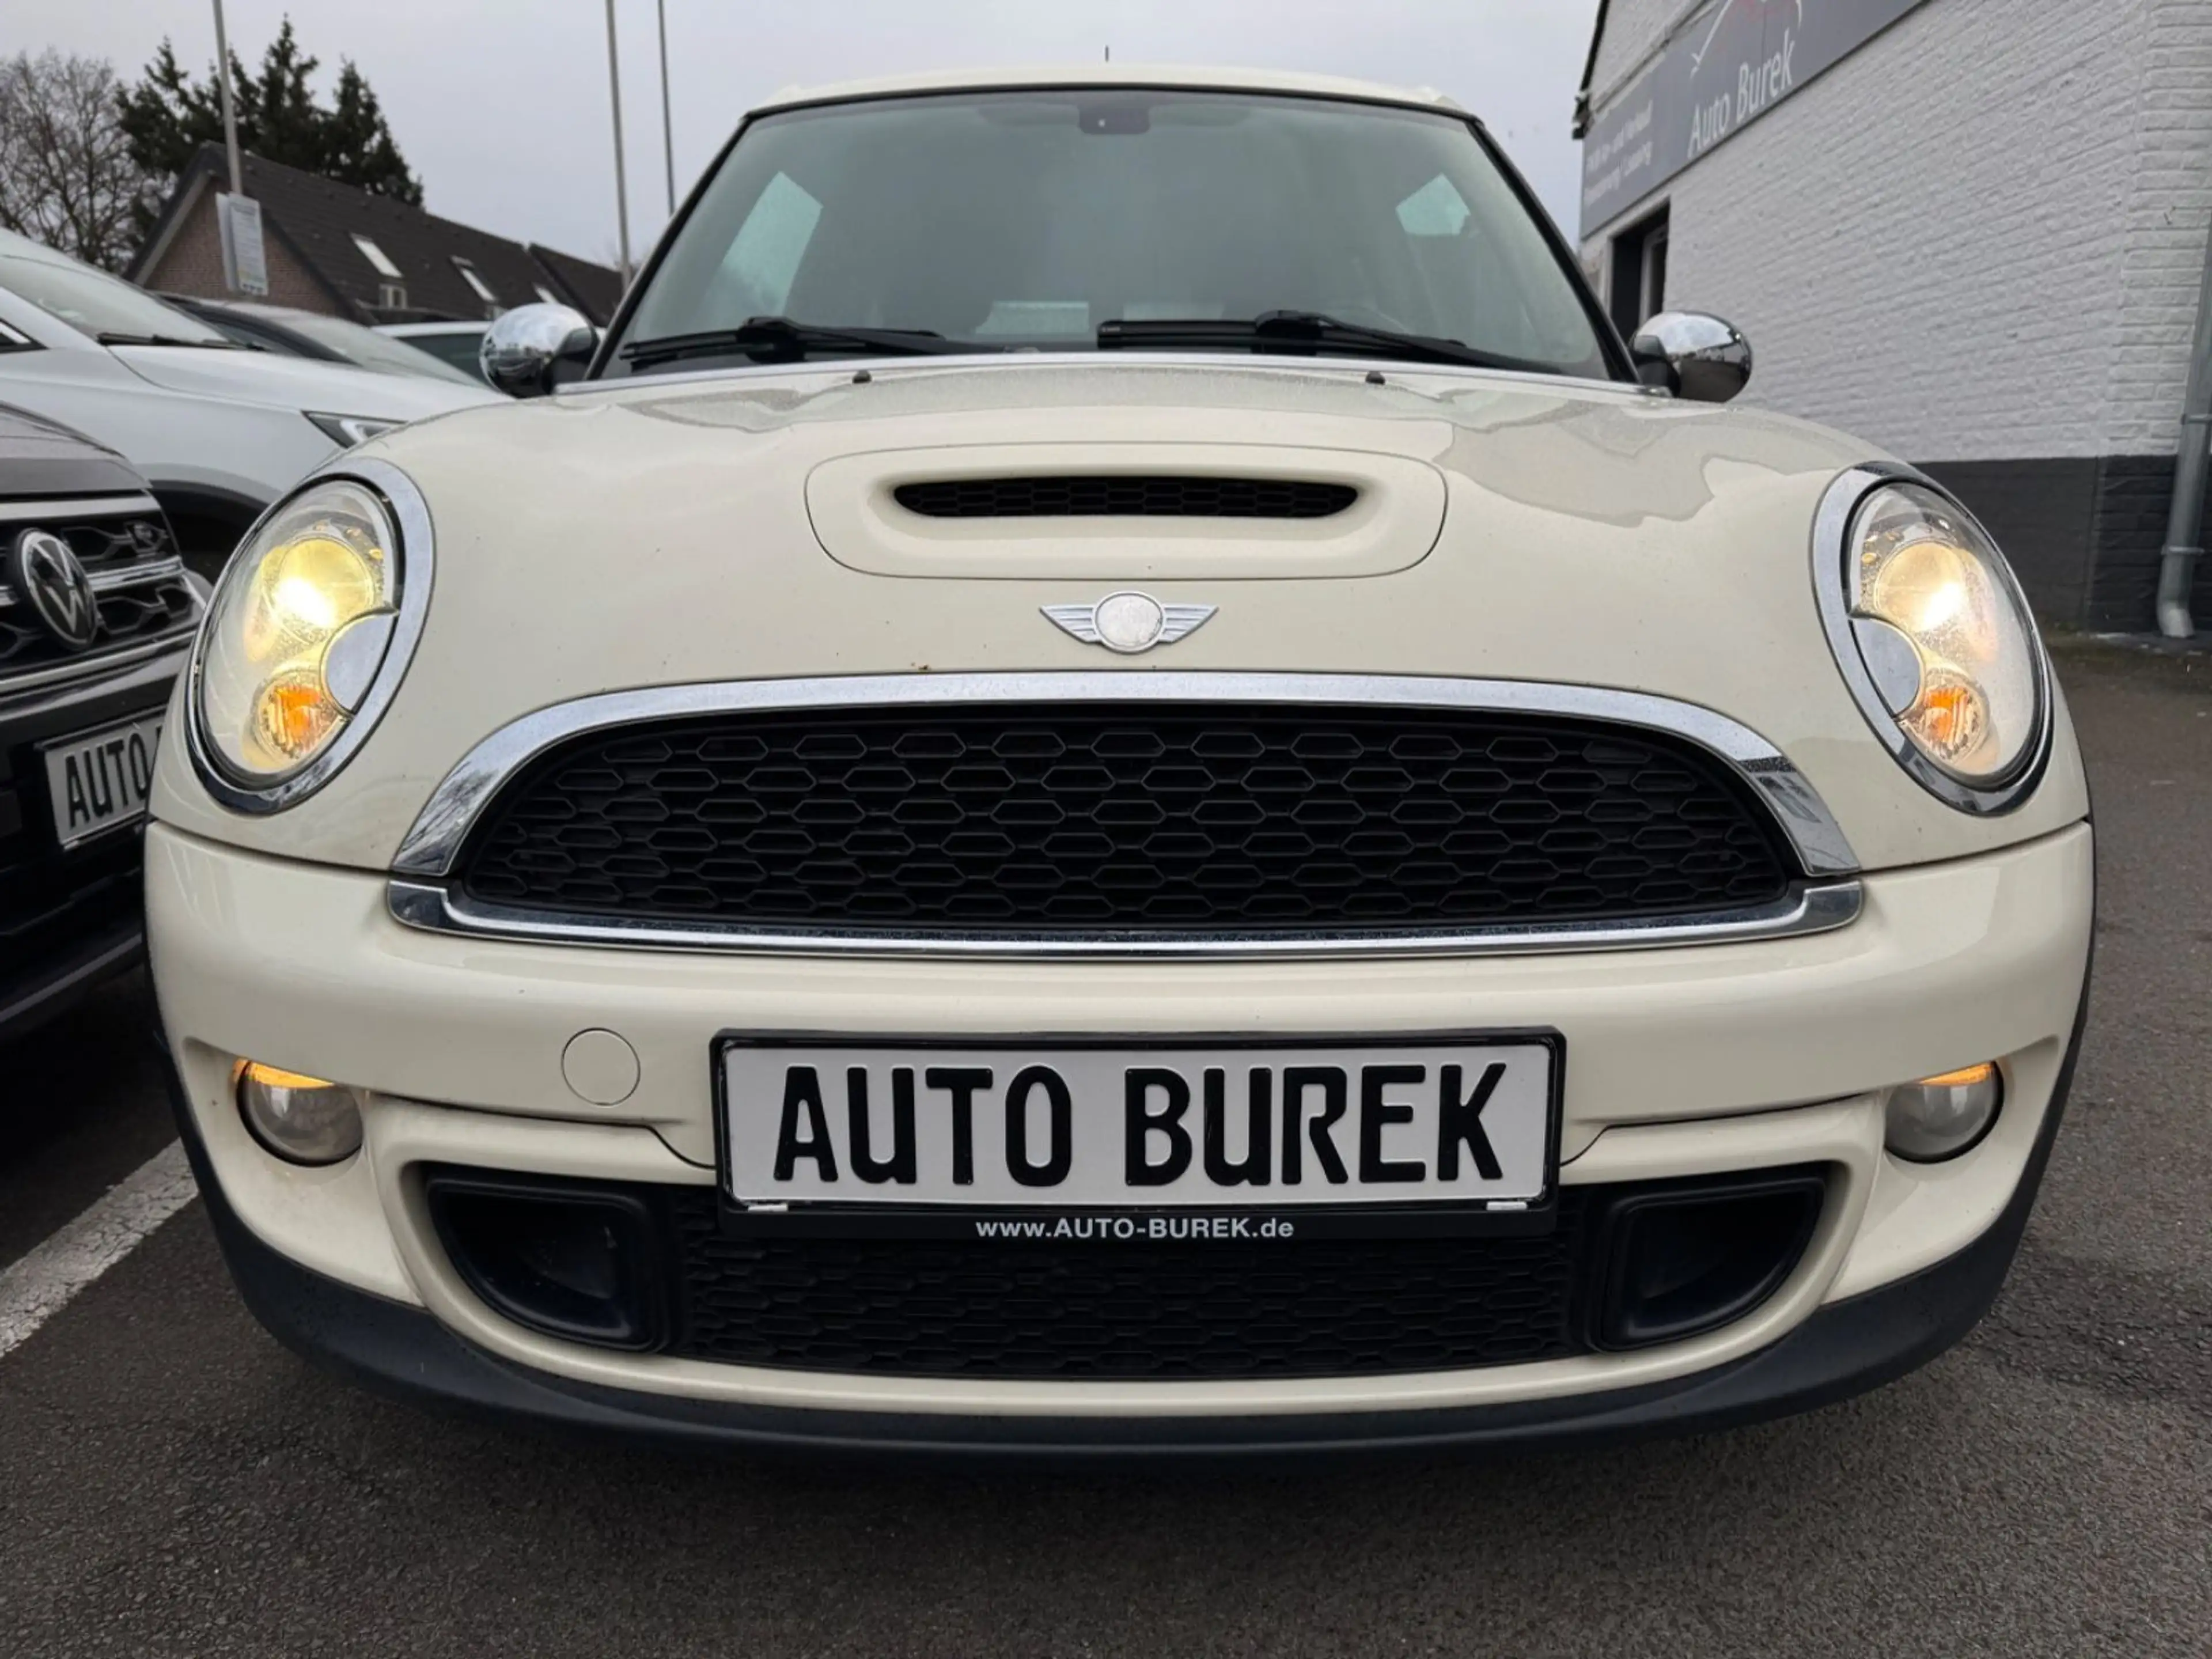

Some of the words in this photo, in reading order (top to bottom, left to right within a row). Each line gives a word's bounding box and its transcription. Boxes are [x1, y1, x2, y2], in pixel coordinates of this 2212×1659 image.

[1687, 93, 1730, 158] Auto
[1736, 28, 1795, 123] Burek
[65, 732, 149, 827] AUTO
[772, 1065, 1073, 1188] AUTO
[1124, 1062, 1508, 1187] BUREK
[975, 1217, 1295, 1238] www.AUTO-BUREK.de
